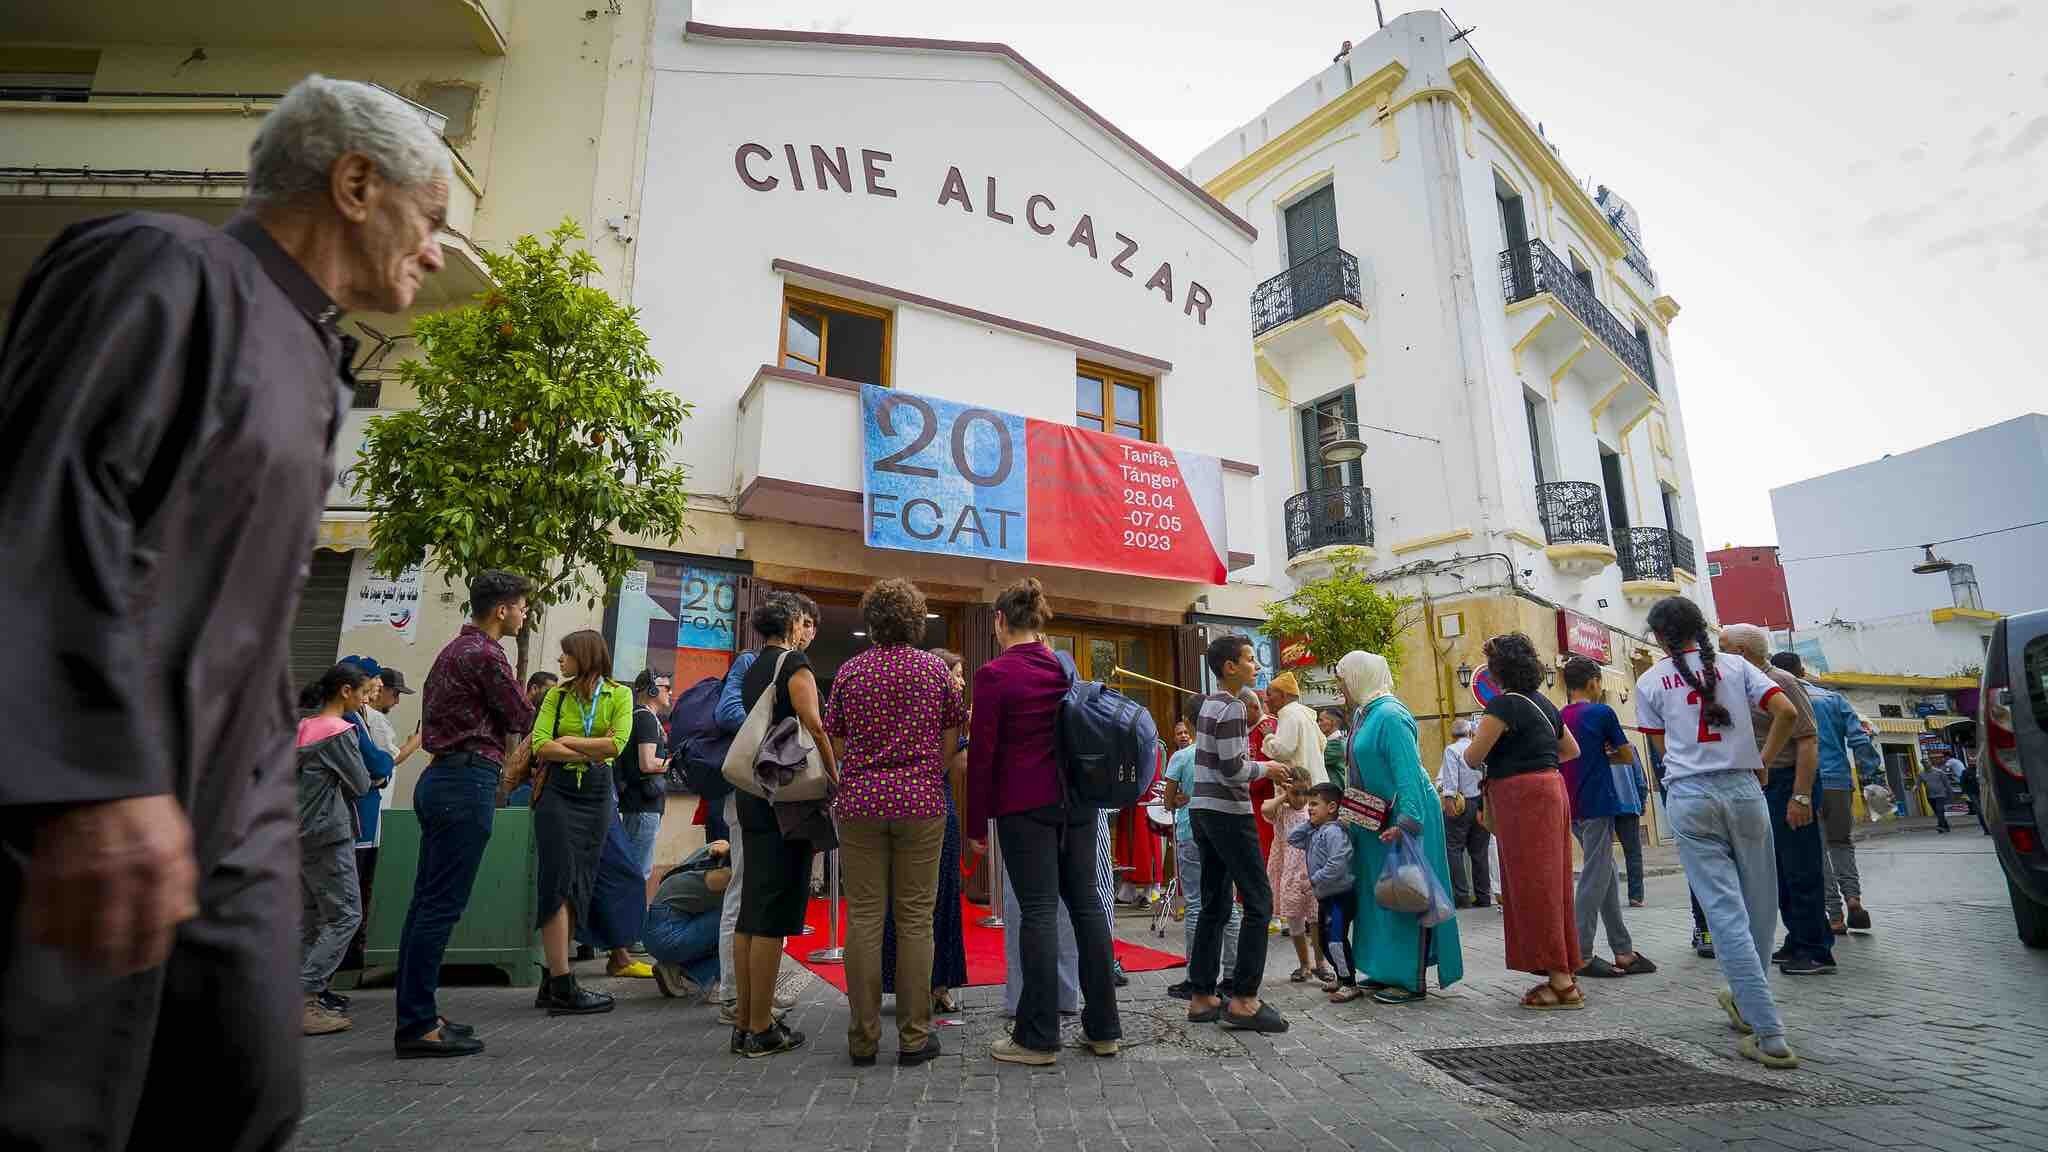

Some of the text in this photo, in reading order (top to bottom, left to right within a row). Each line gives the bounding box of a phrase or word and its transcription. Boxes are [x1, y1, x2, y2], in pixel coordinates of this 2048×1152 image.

[735, 143, 1213, 325] CINE ALCAZAR
[873, 394, 1013, 488] 20
[1120, 444, 1176, 468] Tarifa-
[1120, 464, 1179, 489] Tánger
[1123, 488, 1176, 510] 28.04
[869, 493, 1022, 550] FCAT
[1123, 510, 1182, 532] -07.05
[1123, 530, 1171, 551] 2023
[682, 577, 736, 613] 20
[1686, 690, 1722, 743] 2
